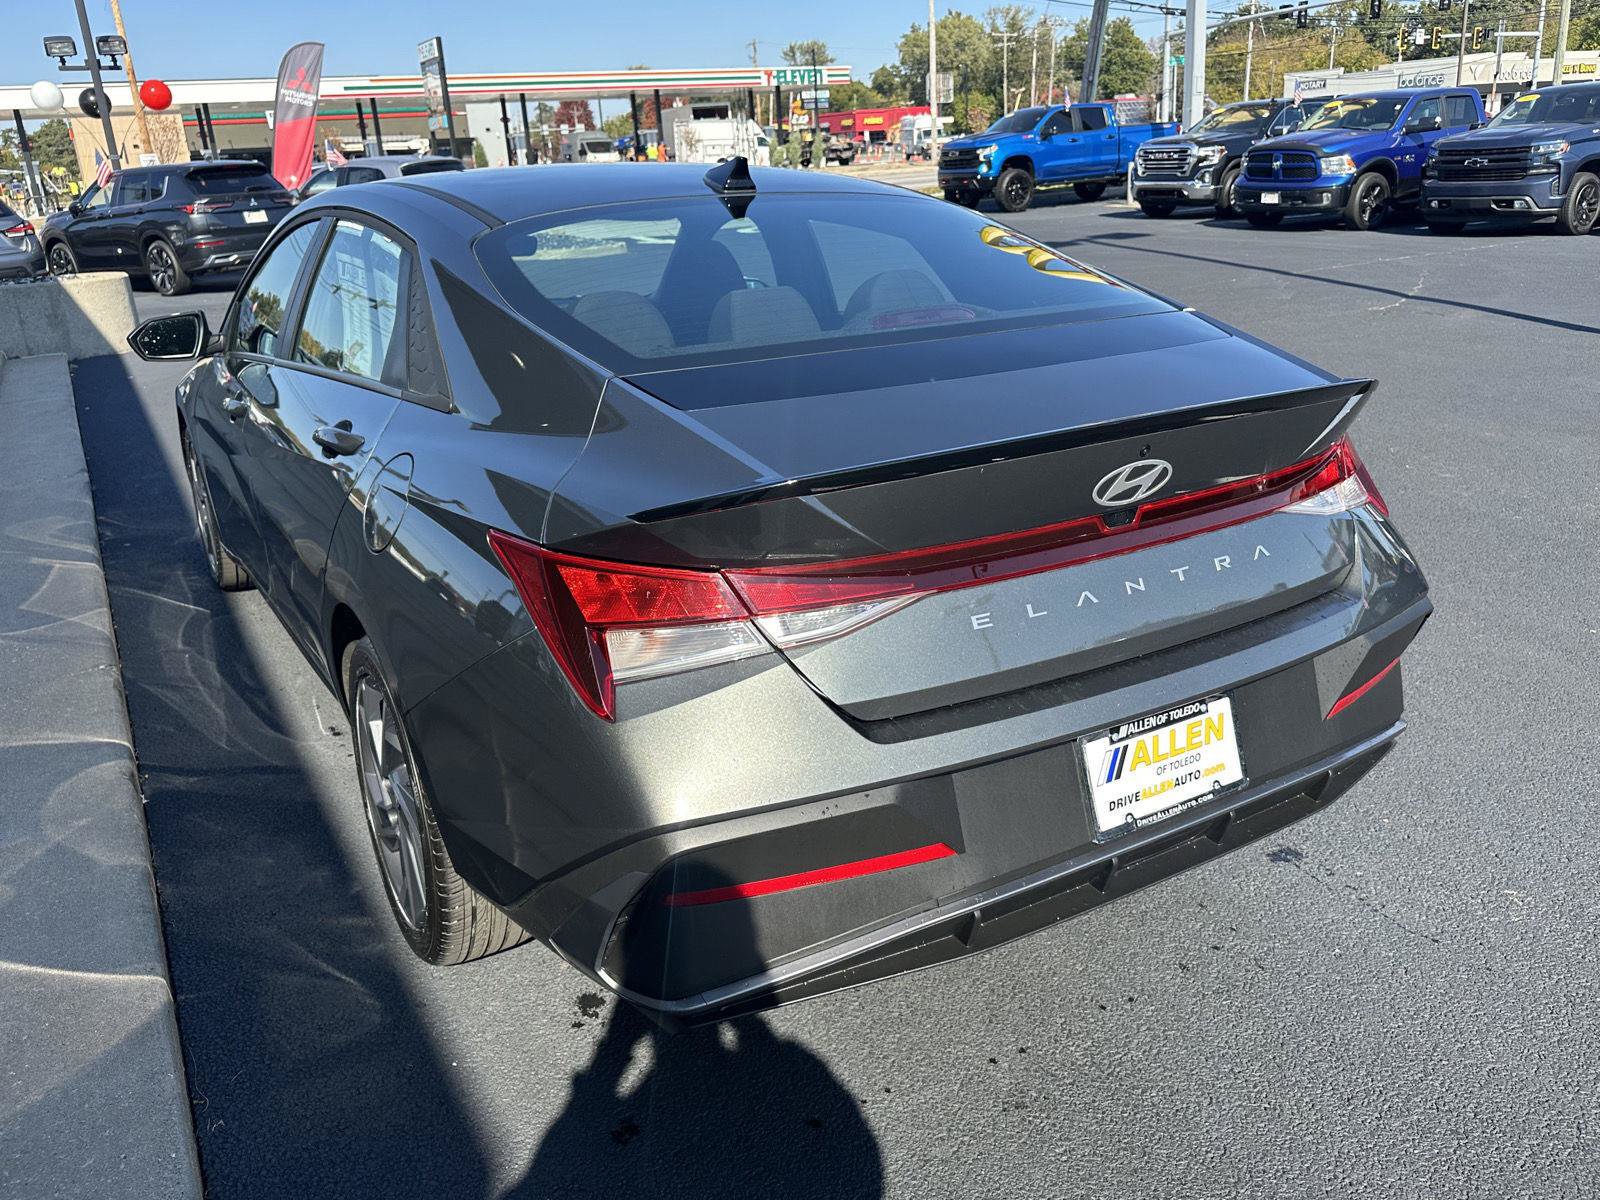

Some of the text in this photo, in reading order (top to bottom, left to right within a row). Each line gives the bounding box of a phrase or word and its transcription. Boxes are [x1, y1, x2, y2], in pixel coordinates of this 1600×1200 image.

[1300, 79, 1325, 90] NOTARY
[285, 96, 313, 107] MOTORS
[970, 545, 1271, 630] ELANTRA
[1127, 702, 1201, 736] ALLEN OF TOLEDO
[1130, 712, 1224, 772] ALLEN
[1156, 752, 1202, 776] OF TOLEDO
